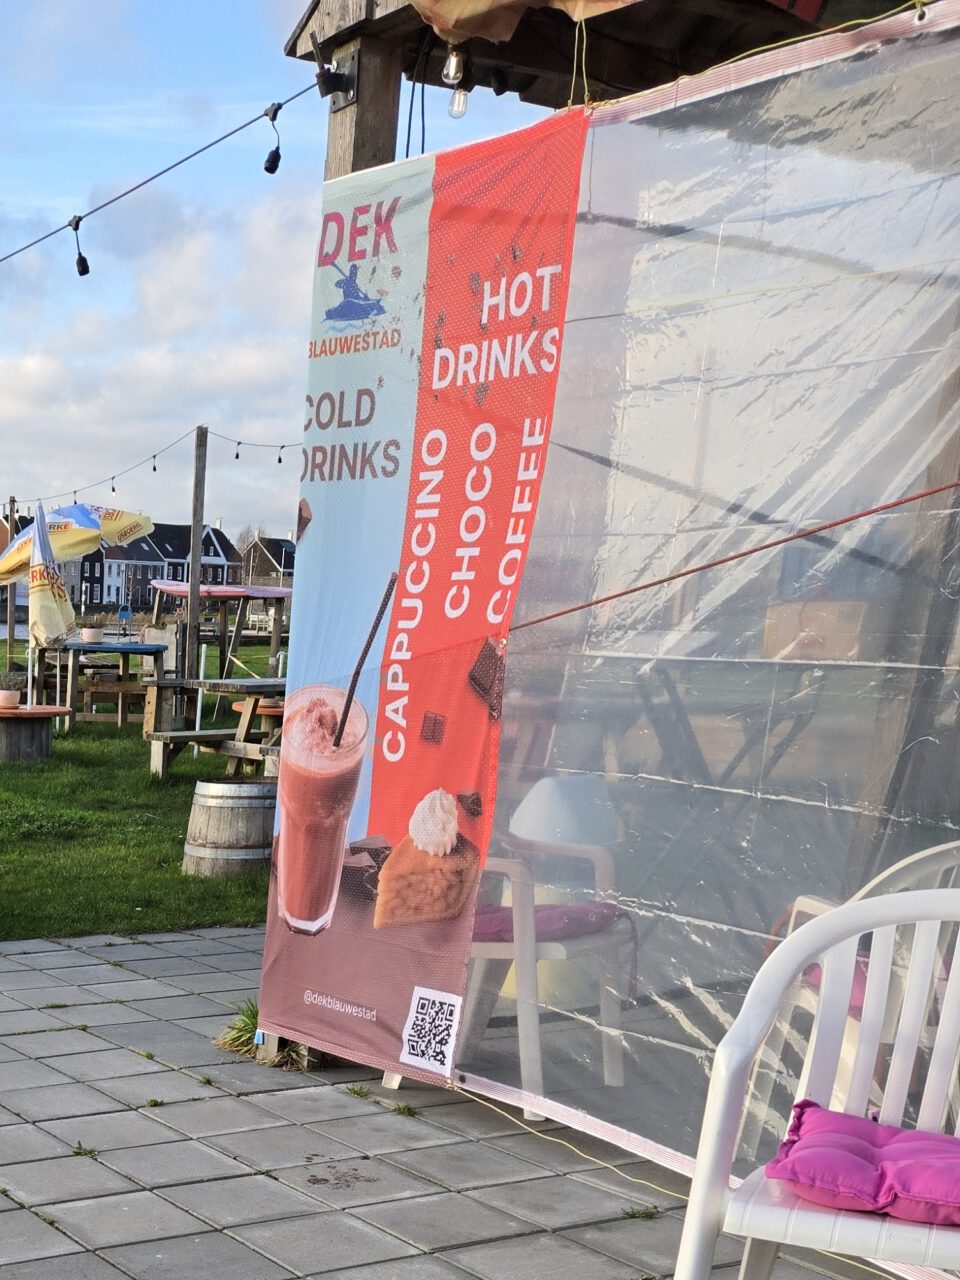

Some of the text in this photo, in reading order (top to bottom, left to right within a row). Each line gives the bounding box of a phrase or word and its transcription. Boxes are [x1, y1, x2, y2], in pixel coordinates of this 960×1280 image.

[318, 196, 402, 268] DEK
[480, 265, 563, 325] HOT
[431, 327, 560, 390] DRINKS
[444, 422, 498, 619] CHOCO
[486, 415, 548, 625] COFFEE
[382, 428, 448, 763] CAPPUCCINO
[303, 989, 378, 1022] @dekblauwestad
